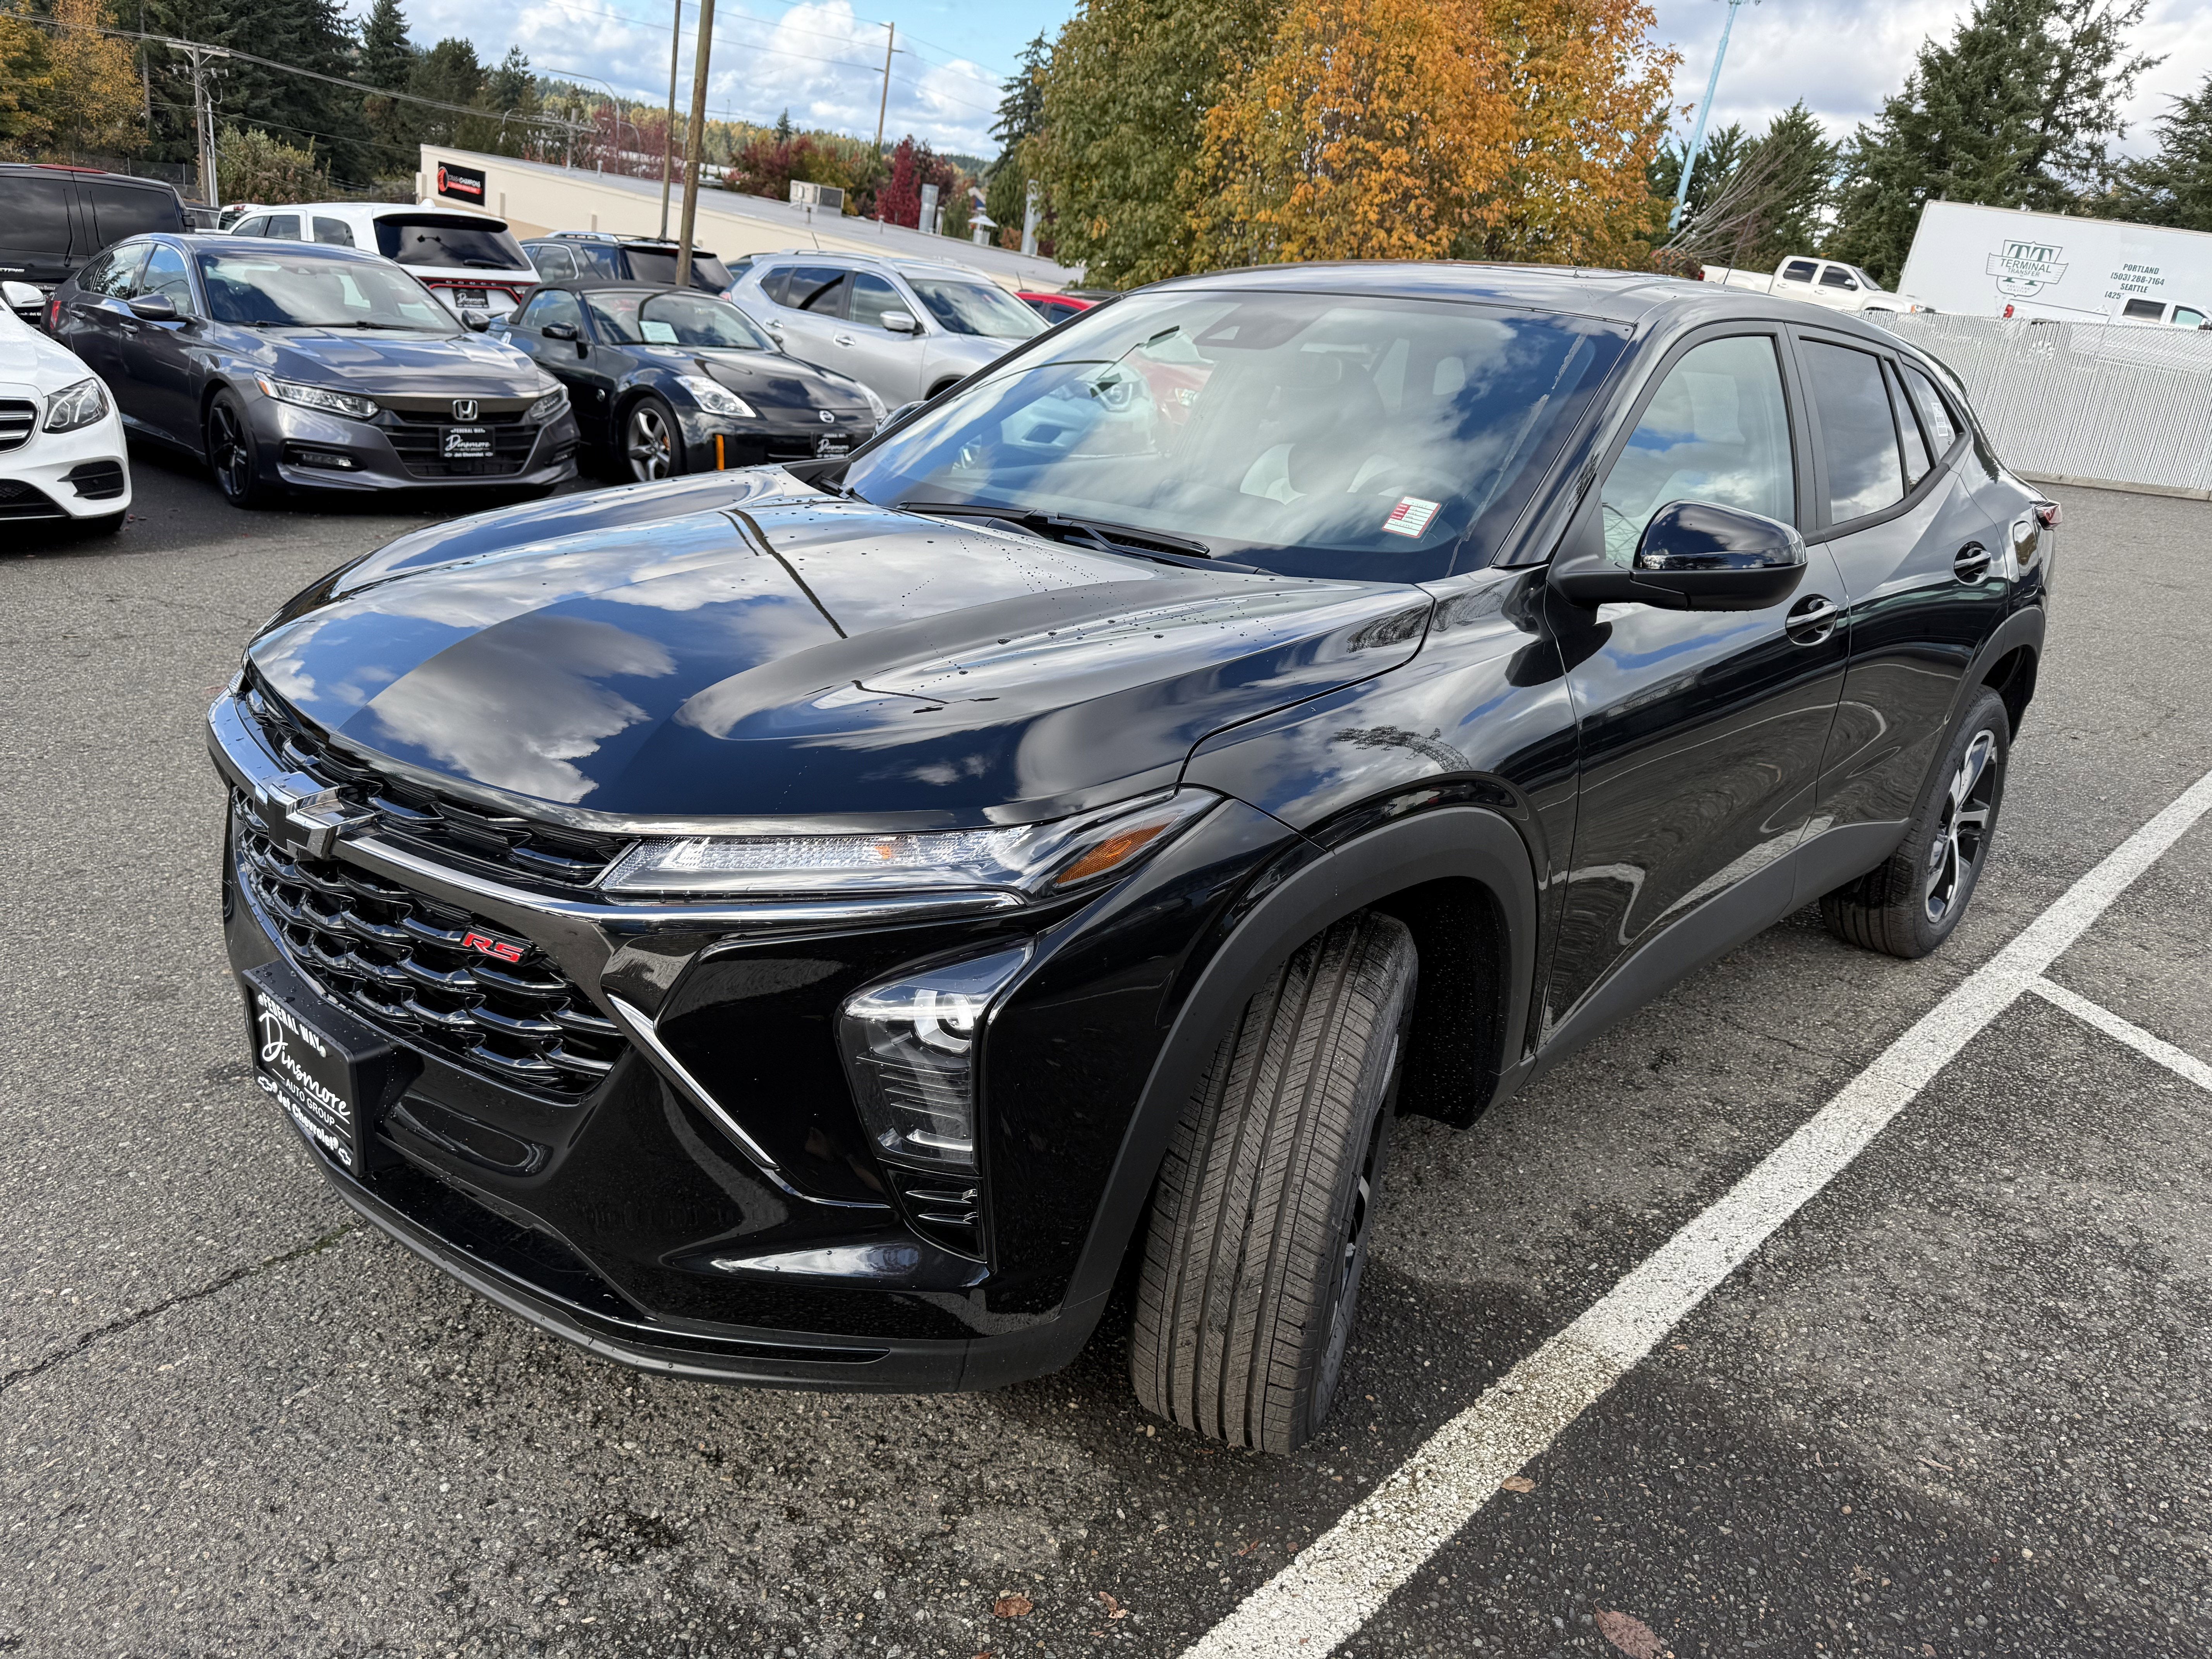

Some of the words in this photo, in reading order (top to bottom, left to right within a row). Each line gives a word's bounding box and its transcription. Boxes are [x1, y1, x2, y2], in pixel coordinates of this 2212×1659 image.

[2001, 258, 2051, 273] TERMINAL
[2008, 268, 2040, 276] TRANSFER
[2123, 264, 2159, 275] PORTLAND
[2111, 272, 2131, 281] (503)
[2131, 275, 2165, 285] 288-7164
[2105, 291, 2124, 299] (425
[2120, 283, 2148, 293] SEATTLE
[463, 932, 524, 962] RS
[262, 992, 299, 1035] FEDERAL
[299, 1024, 320, 1051] WAY
[259, 1010, 350, 1116] Dinsmore
[285, 1079, 305, 1102] AUTO
[307, 1098, 335, 1126] GROUP
[277, 1090, 291, 1111] Jet
[292, 1103, 335, 1151] Chevrolet
